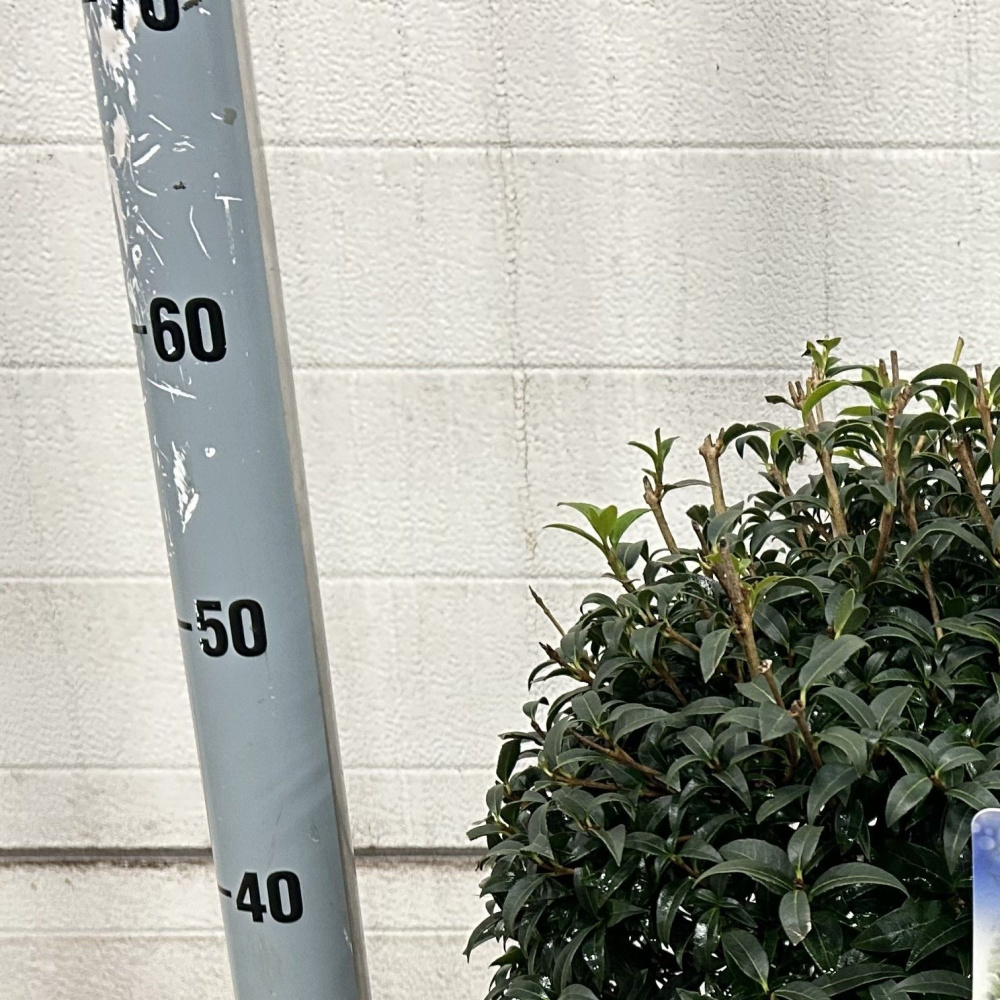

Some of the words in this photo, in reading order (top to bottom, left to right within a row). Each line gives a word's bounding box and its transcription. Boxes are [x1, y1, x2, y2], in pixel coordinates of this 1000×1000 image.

[150, 297, 227, 362] 60
[195, 599, 267, 658] 50
[236, 871, 304, 923] 40
